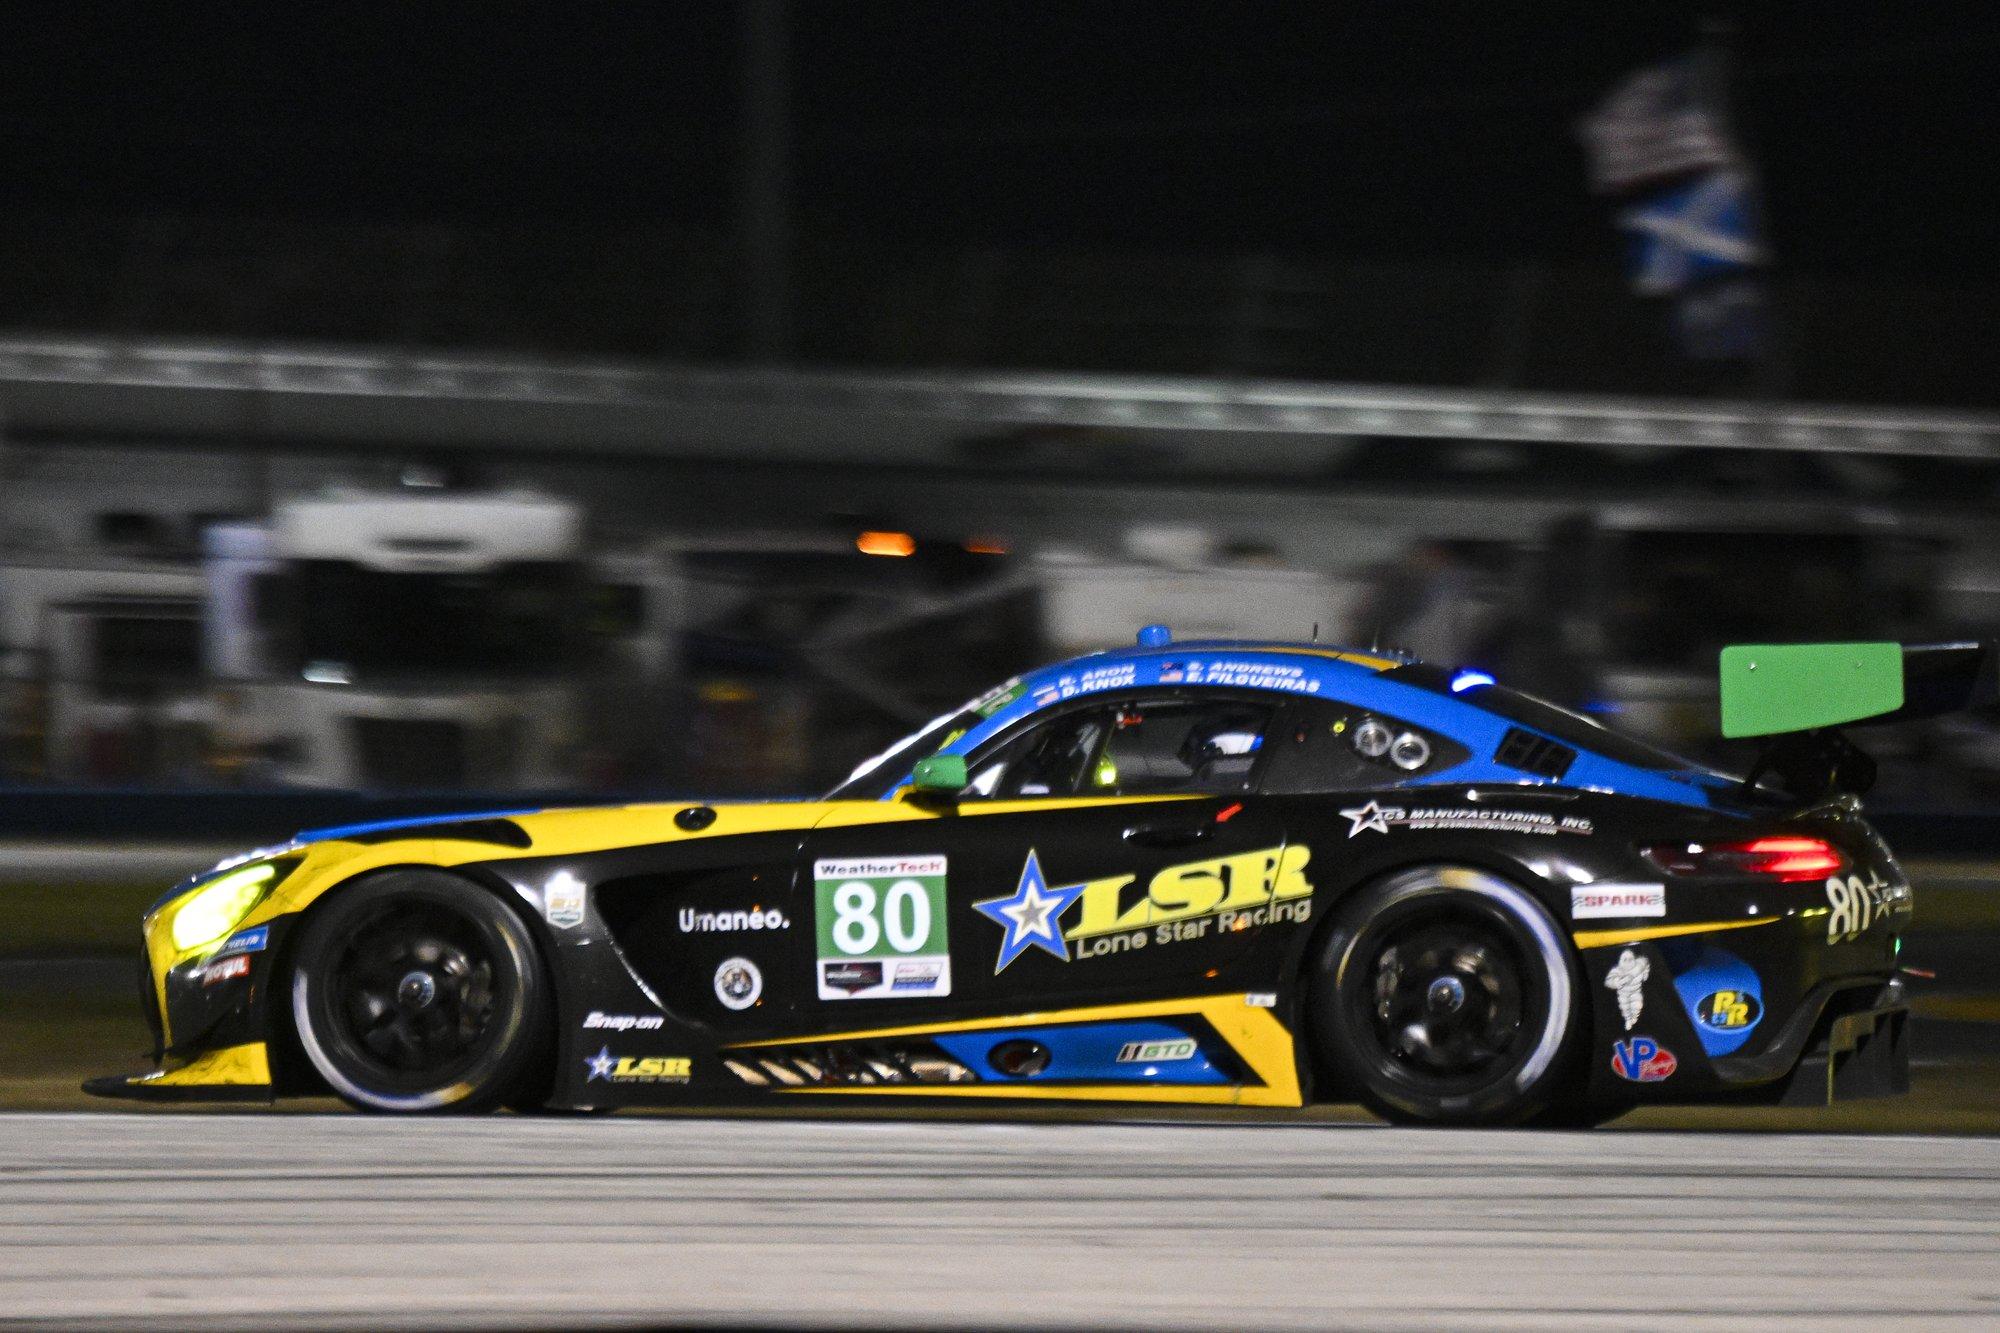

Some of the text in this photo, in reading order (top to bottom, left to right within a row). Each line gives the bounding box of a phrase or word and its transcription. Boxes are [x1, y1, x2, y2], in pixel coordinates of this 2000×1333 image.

[1561, 816, 1594, 831] INC.
[821, 862, 941, 875] WeatherTech
[1064, 846, 1314, 942] LSR
[1584, 895, 1652, 907] SPARK
[1825, 875, 1871, 945] 80
[832, 880, 931, 955] 80
[1076, 898, 1312, 960] Lone Star Racing
[613, 1056, 691, 1076] LSR
[1613, 1037, 1658, 1081] VP
